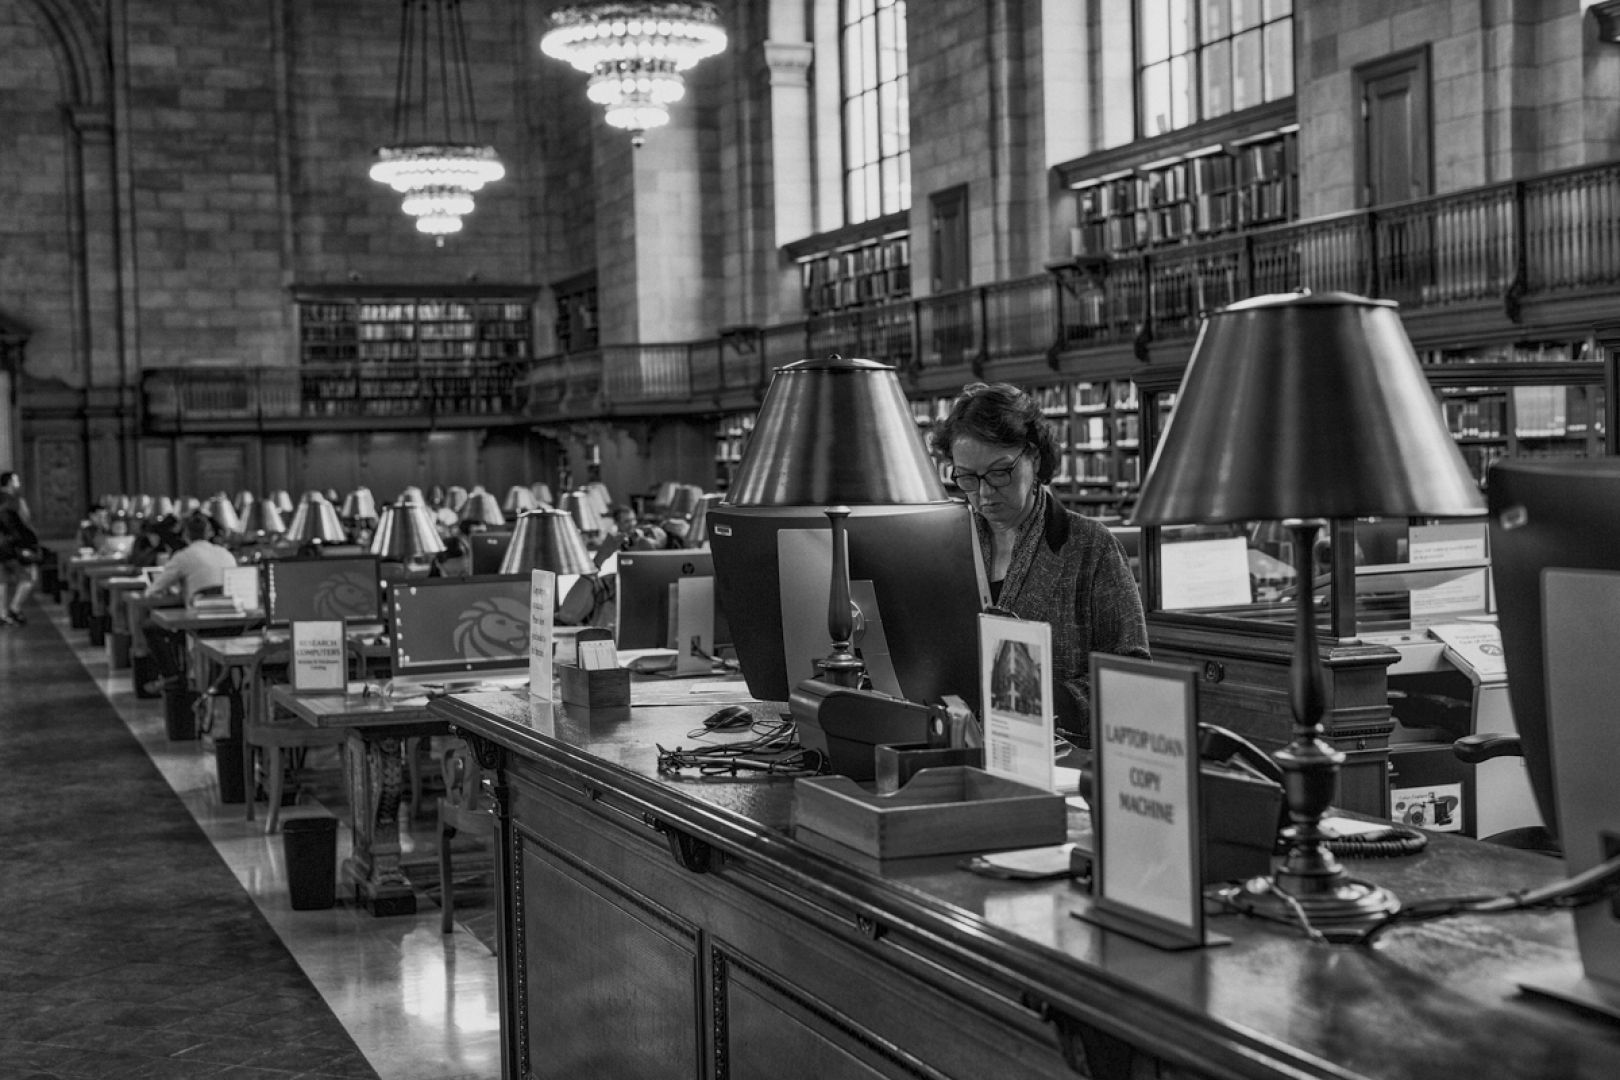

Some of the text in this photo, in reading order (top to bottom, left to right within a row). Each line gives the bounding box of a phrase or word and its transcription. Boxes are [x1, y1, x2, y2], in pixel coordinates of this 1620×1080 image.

[296, 648, 341, 656] COMPUTERS
[299, 639, 337, 647] RESEARCH
[1105, 724, 1185, 757] LAPTOP LOAN
[1129, 766, 1161, 792] COPY
[1118, 791, 1175, 825] MACHINE
